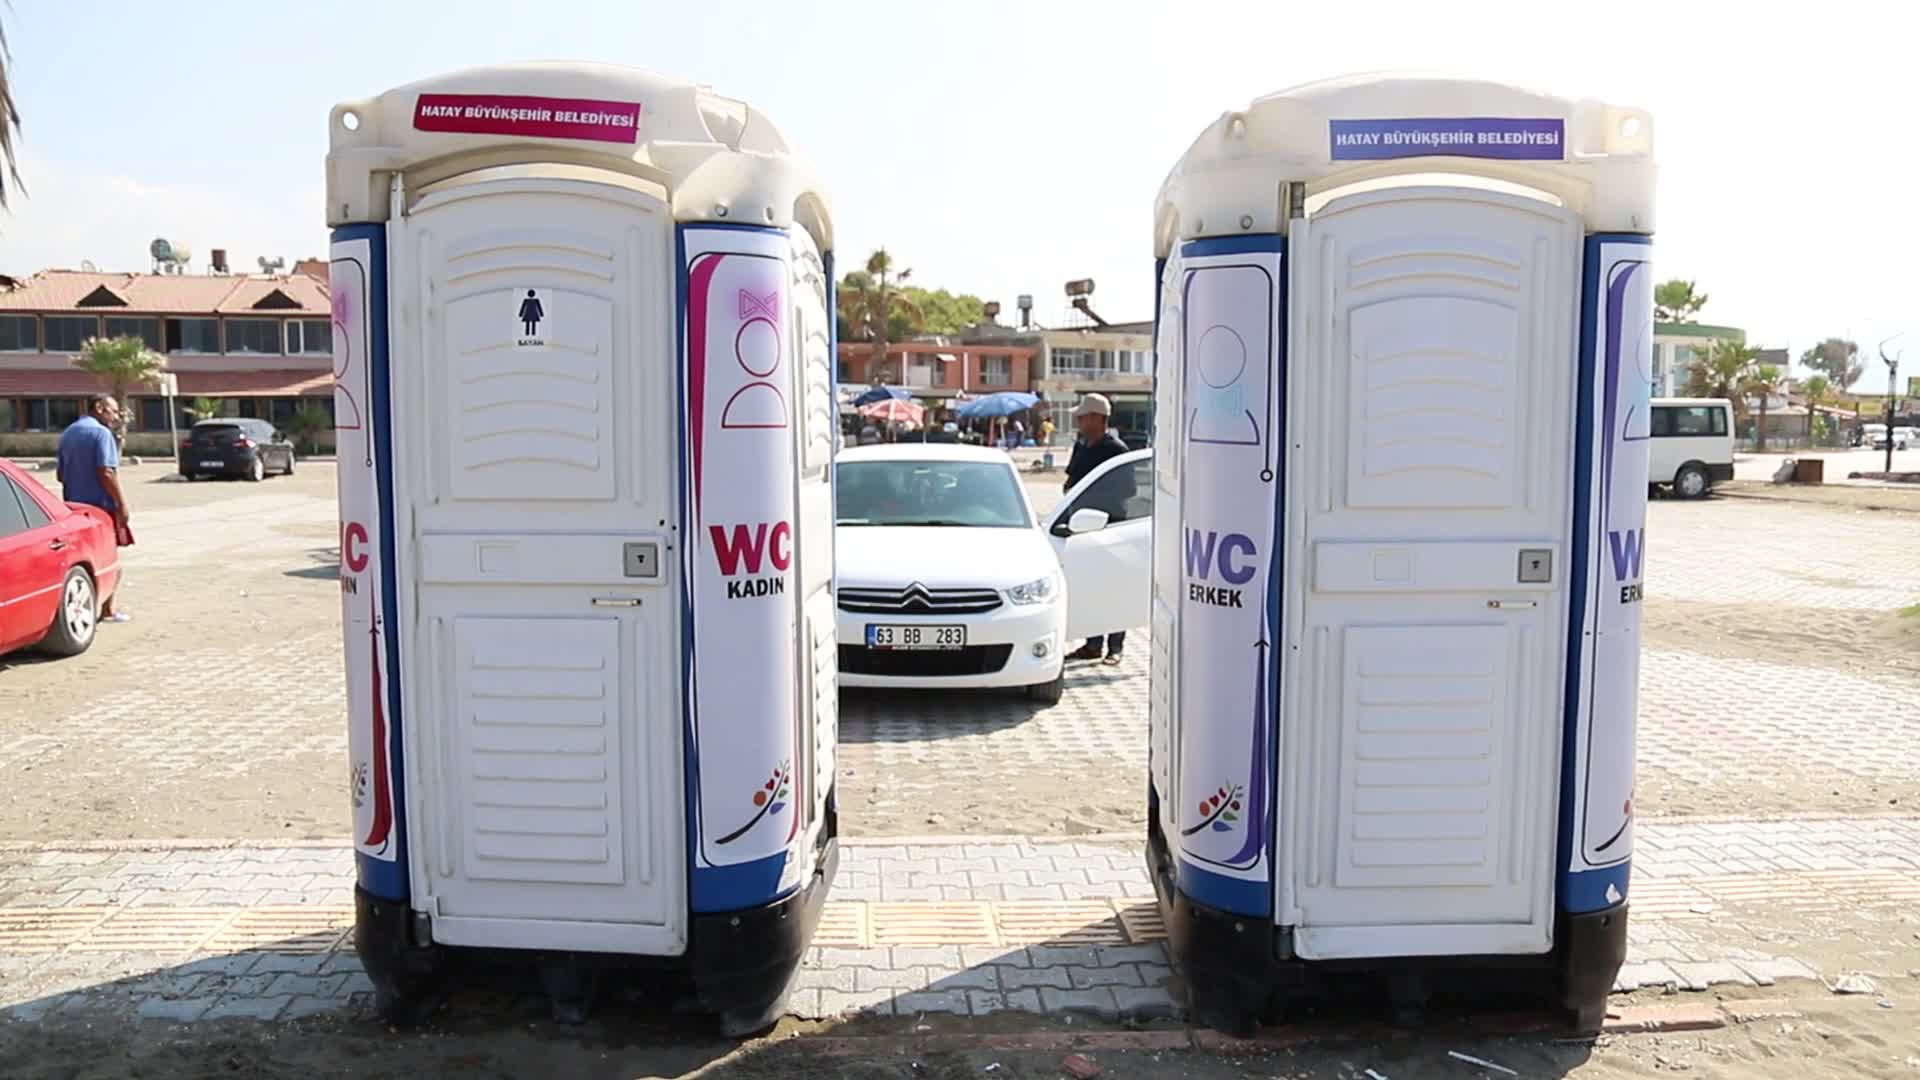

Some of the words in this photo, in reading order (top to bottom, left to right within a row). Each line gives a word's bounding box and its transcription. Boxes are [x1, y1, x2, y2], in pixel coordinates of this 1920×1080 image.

[421, 105, 462, 118] HATAY
[465, 104, 551, 122] BÜYÜKŞEHİR
[555, 111, 634, 127] BELEDİYESİ
[1336, 133, 1380, 146] HATAY
[1384, 130, 1474, 147] BÜYÜKŞEHİR
[1478, 130, 1559, 146] BELEDİYESİ
[341, 521, 368, 573] C
[709, 521, 791, 576] WC
[1184, 528, 1257, 585] WC
[728, 577, 784, 599] KADIN
[1189, 583, 1242, 608] ERKEK
[876, 628, 893, 644] 63
[904, 628, 921, 644] BB
[936, 628, 962, 644] 283
